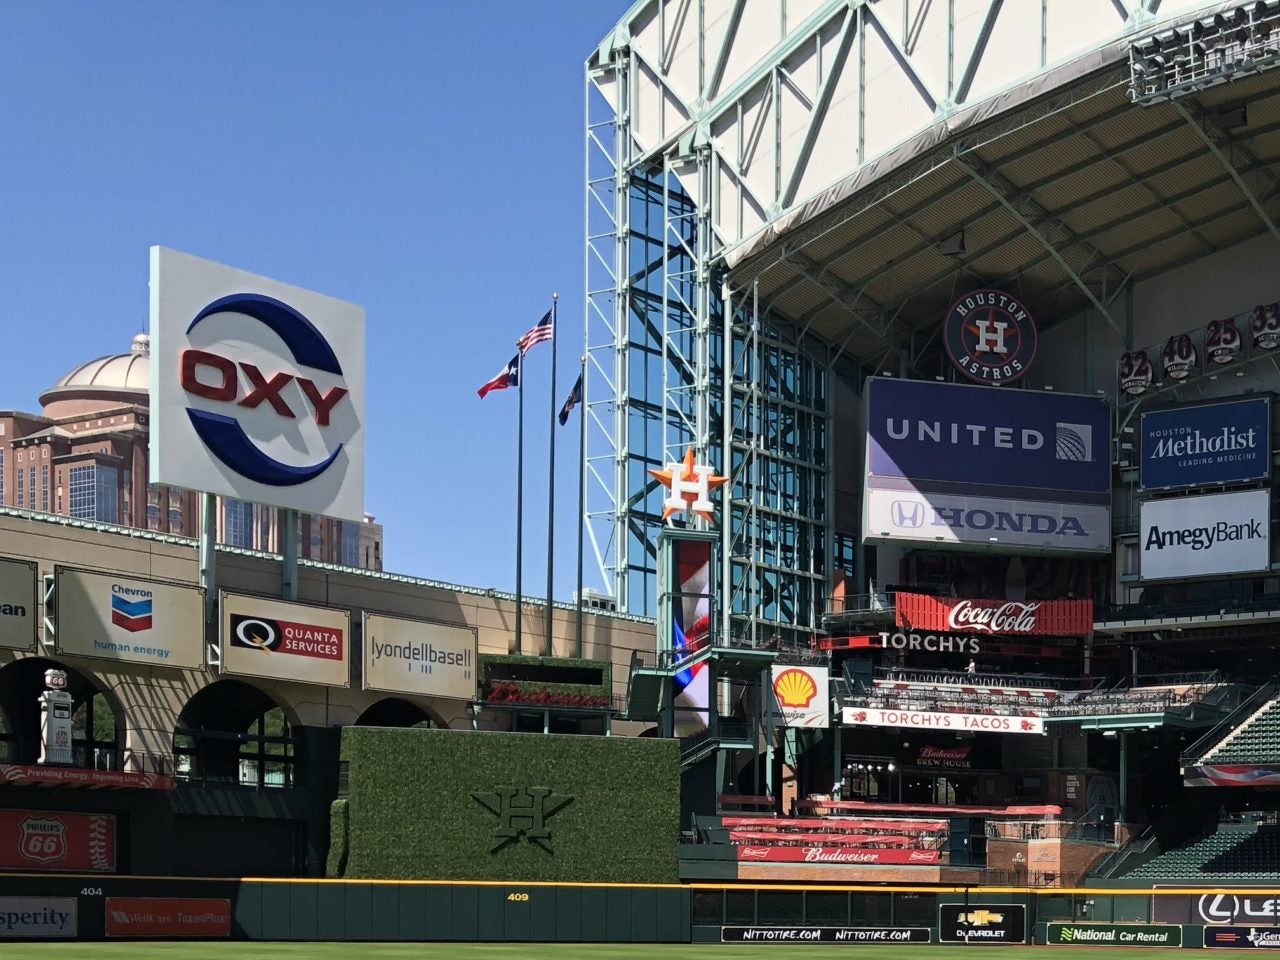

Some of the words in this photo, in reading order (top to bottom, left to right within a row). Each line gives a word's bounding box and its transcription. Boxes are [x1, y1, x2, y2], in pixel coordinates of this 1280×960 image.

[956, 293, 1027, 322] HOUSTON
[1253, 302, 1280, 332] 33
[1206, 318, 1237, 347] 25
[1162, 333, 1192, 363] 40
[959, 355, 1022, 379] ASTROS
[1120, 350, 1148, 379] 32
[180, 348, 349, 426] OXY
[886, 417, 1044, 450] UNITED
[1150, 426, 1192, 438] HOUSTON
[1150, 426, 1256, 459] Methodist
[1178, 456, 1213, 467] LEADING
[1217, 452, 1256, 463] MEDICINE
[931, 506, 1089, 537] HONDA
[1145, 518, 1262, 550] AmegyBank
[111, 584, 153, 598] Chevron
[949, 600, 1041, 633] Coca-Cola
[285, 627, 339, 644] QUANTA
[878, 631, 981, 654] TORCHYS
[94, 639, 130, 653] human
[133, 646, 170, 659] energy
[285, 640, 338, 656] SERVICES
[372, 636, 471, 667] lyondellbasell
[880, 711, 951, 727] TORCHYS
[962, 715, 1011, 730] TACOS
[916, 758, 941, 766] BREW
[942, 759, 972, 768] HOUSE
[26, 822, 61, 833] PHILLIPS
[29, 836, 57, 854] 66
[802, 847, 880, 862] Budweiser
[80, 887, 103, 896] 404
[507, 892, 529, 901] 409
[742, 928, 821, 941] NITTOTIRE.COM
[834, 928, 911, 942] NITTOTIRE.COM
[1073, 927, 1115, 941] National
[1119, 931, 1136, 942] Car
[1137, 931, 1168, 943] Rental
